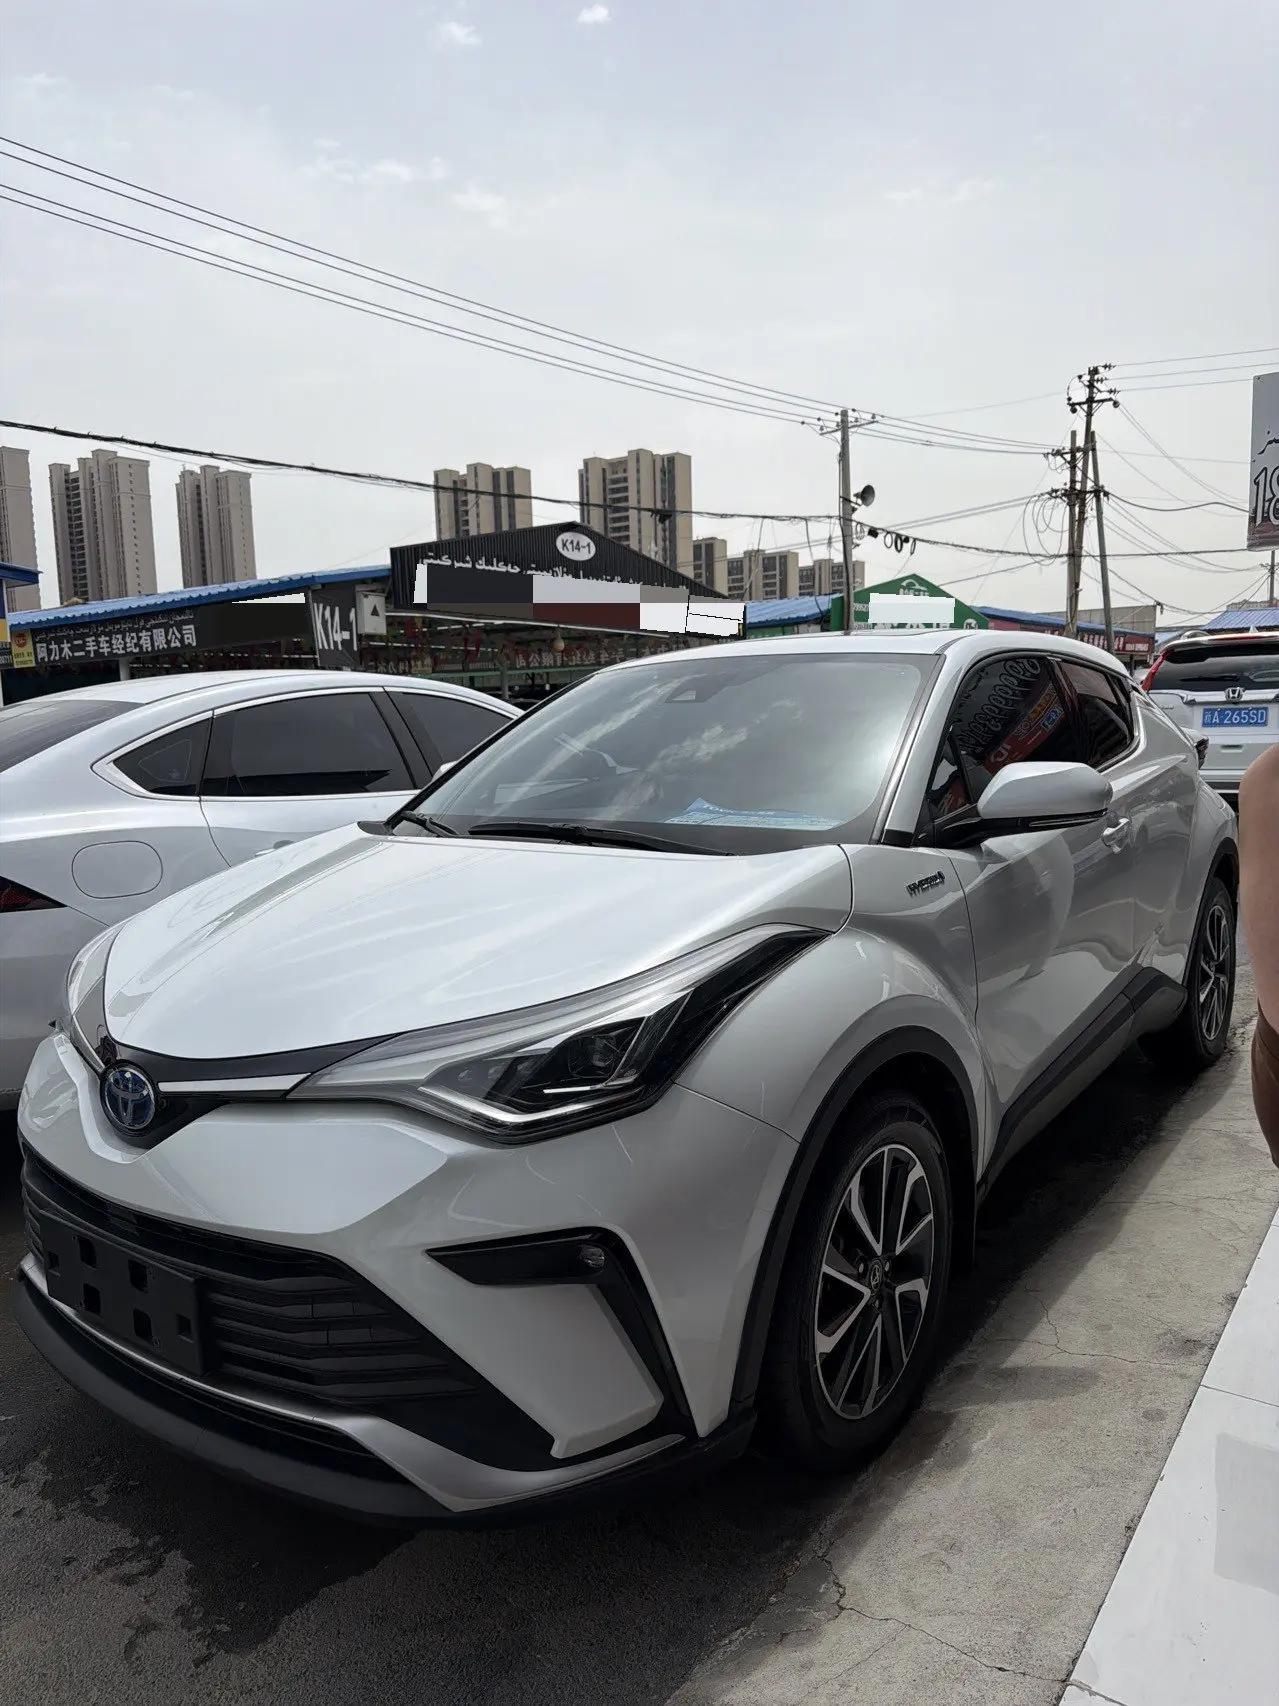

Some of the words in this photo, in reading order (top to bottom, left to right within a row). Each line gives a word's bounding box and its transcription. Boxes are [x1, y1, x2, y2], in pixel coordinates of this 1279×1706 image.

[561, 538, 592, 555] K14-1
[35, 624, 198, 662] 阿力木二手车经纪有限公司
[313, 602, 358, 651] K14-1
